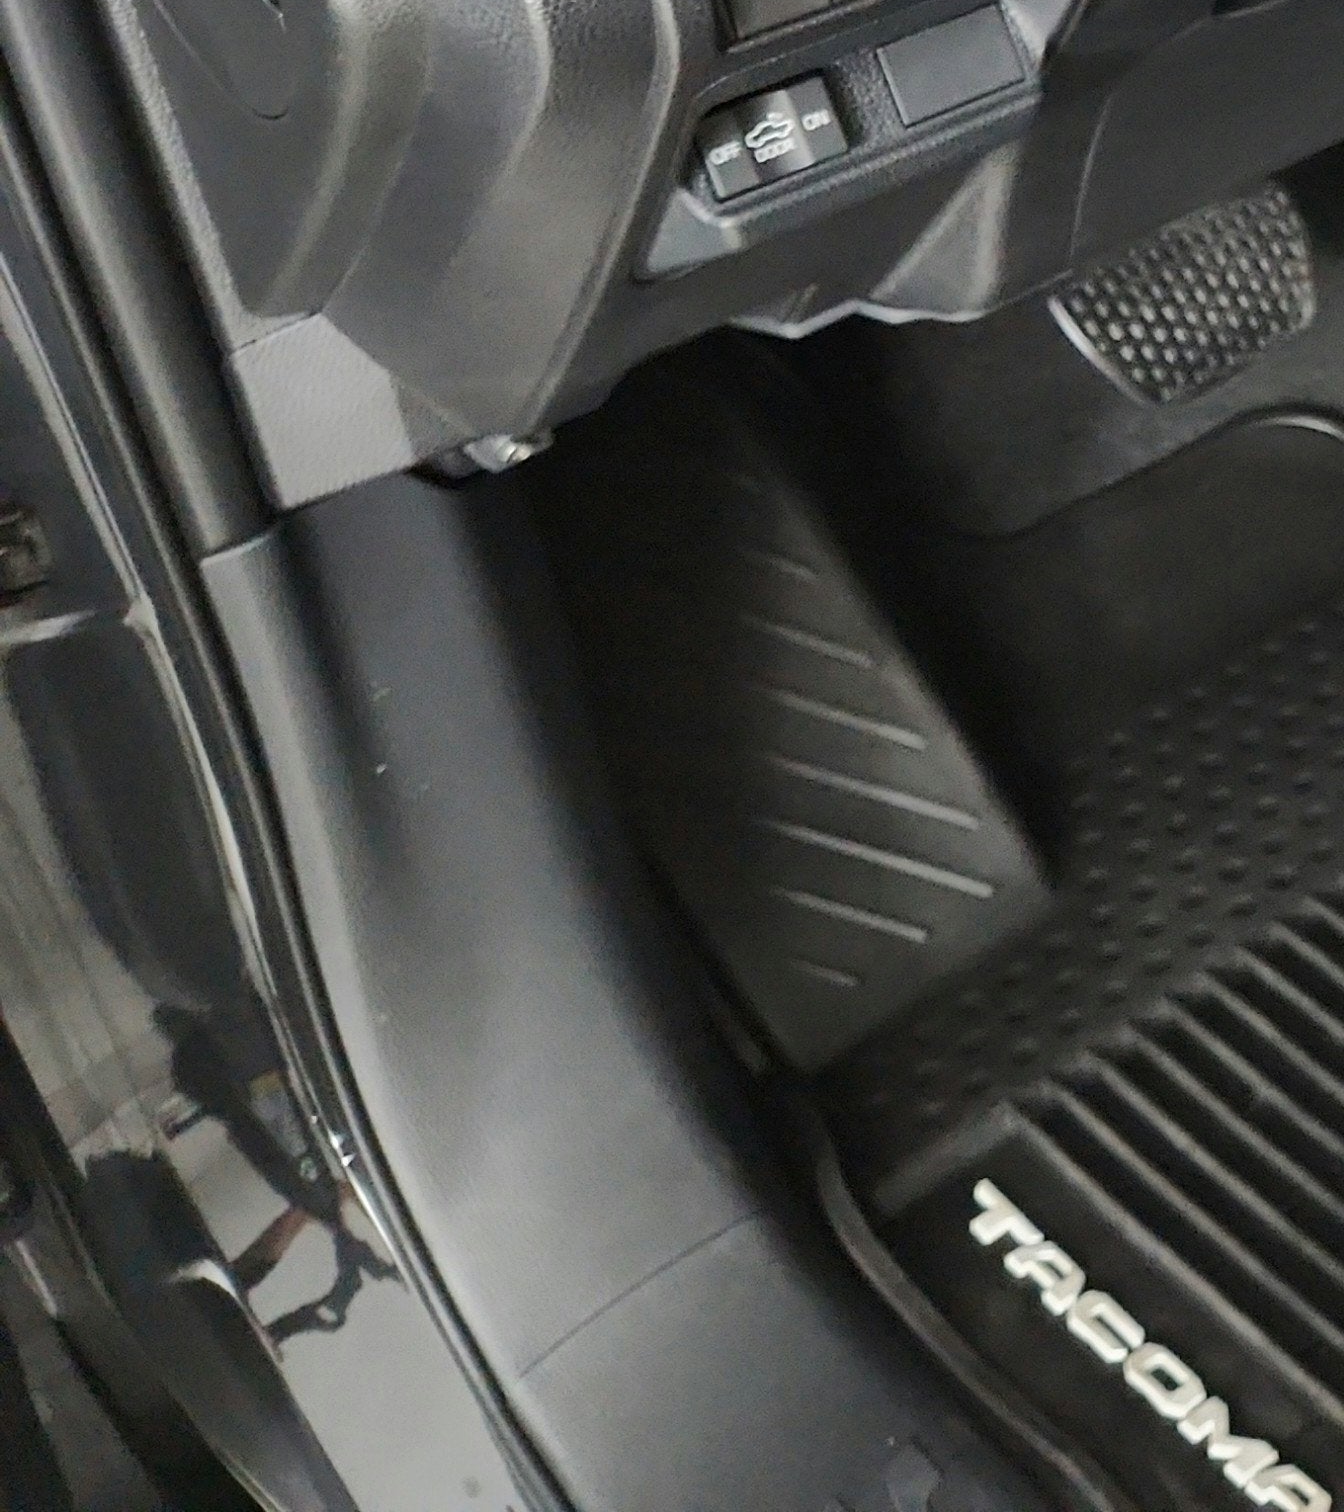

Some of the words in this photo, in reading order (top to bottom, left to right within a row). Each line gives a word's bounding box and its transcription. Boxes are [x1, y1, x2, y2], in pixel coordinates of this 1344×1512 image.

[801, 109, 831, 131] ON
[708, 140, 742, 166] OFF
[968, 1177, 1334, 1512] TACOMA
